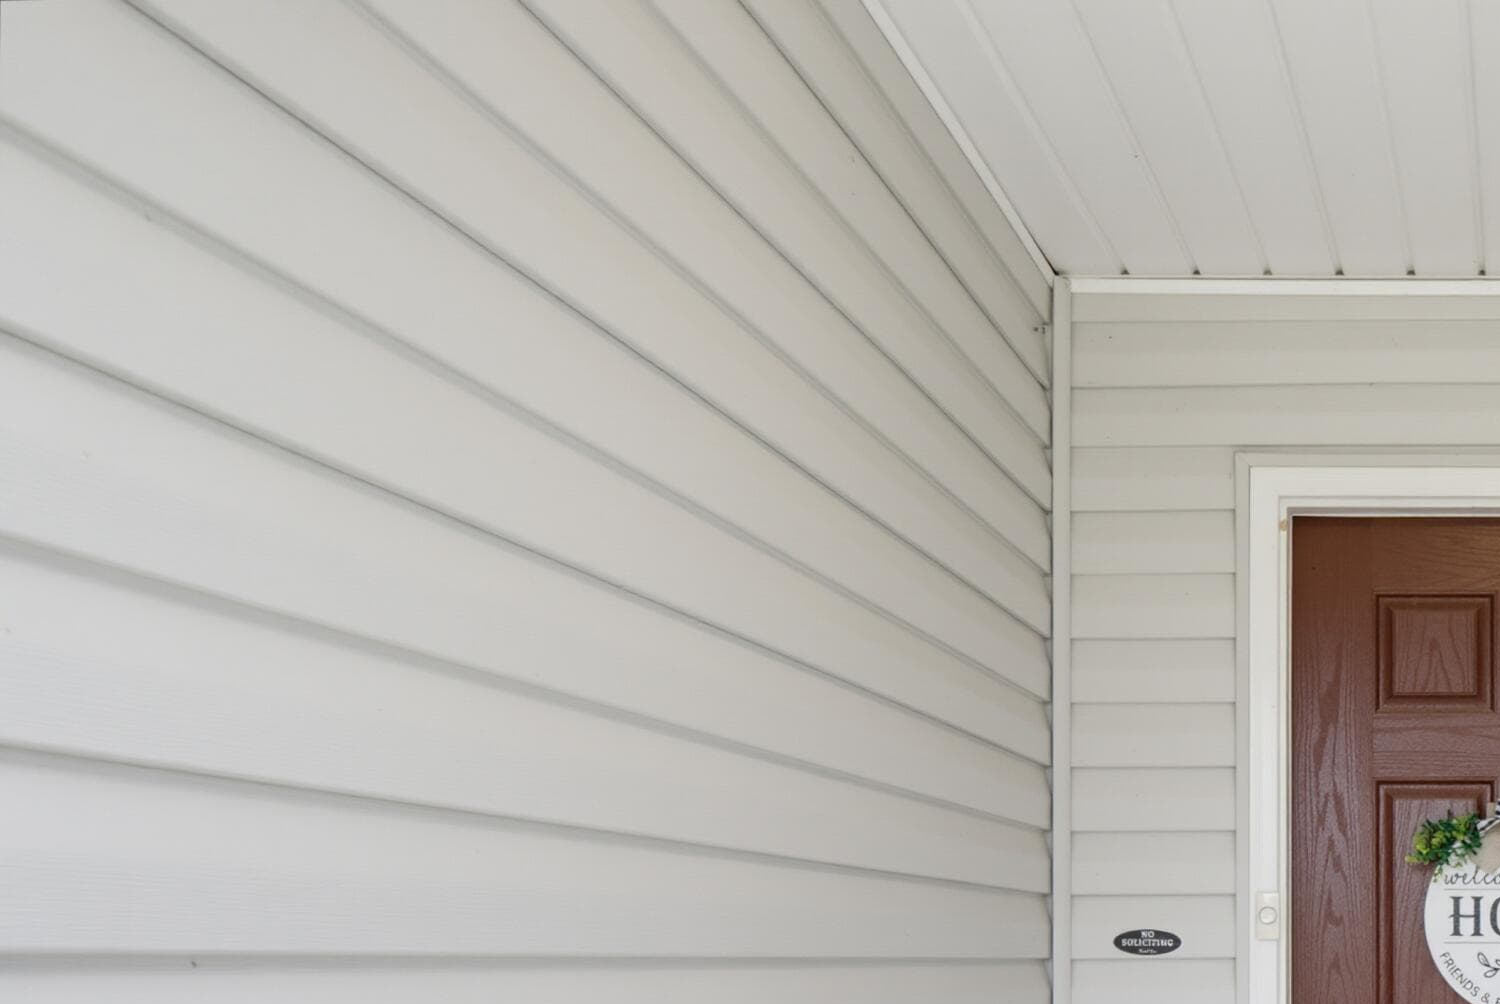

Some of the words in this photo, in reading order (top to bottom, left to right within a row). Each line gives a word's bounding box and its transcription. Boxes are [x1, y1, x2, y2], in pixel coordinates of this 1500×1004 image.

[1121, 938, 1174, 947] SOLICITING
[1440, 951, 1480, 997] FRIENDS
[1480, 993, 1490, 1004] &
